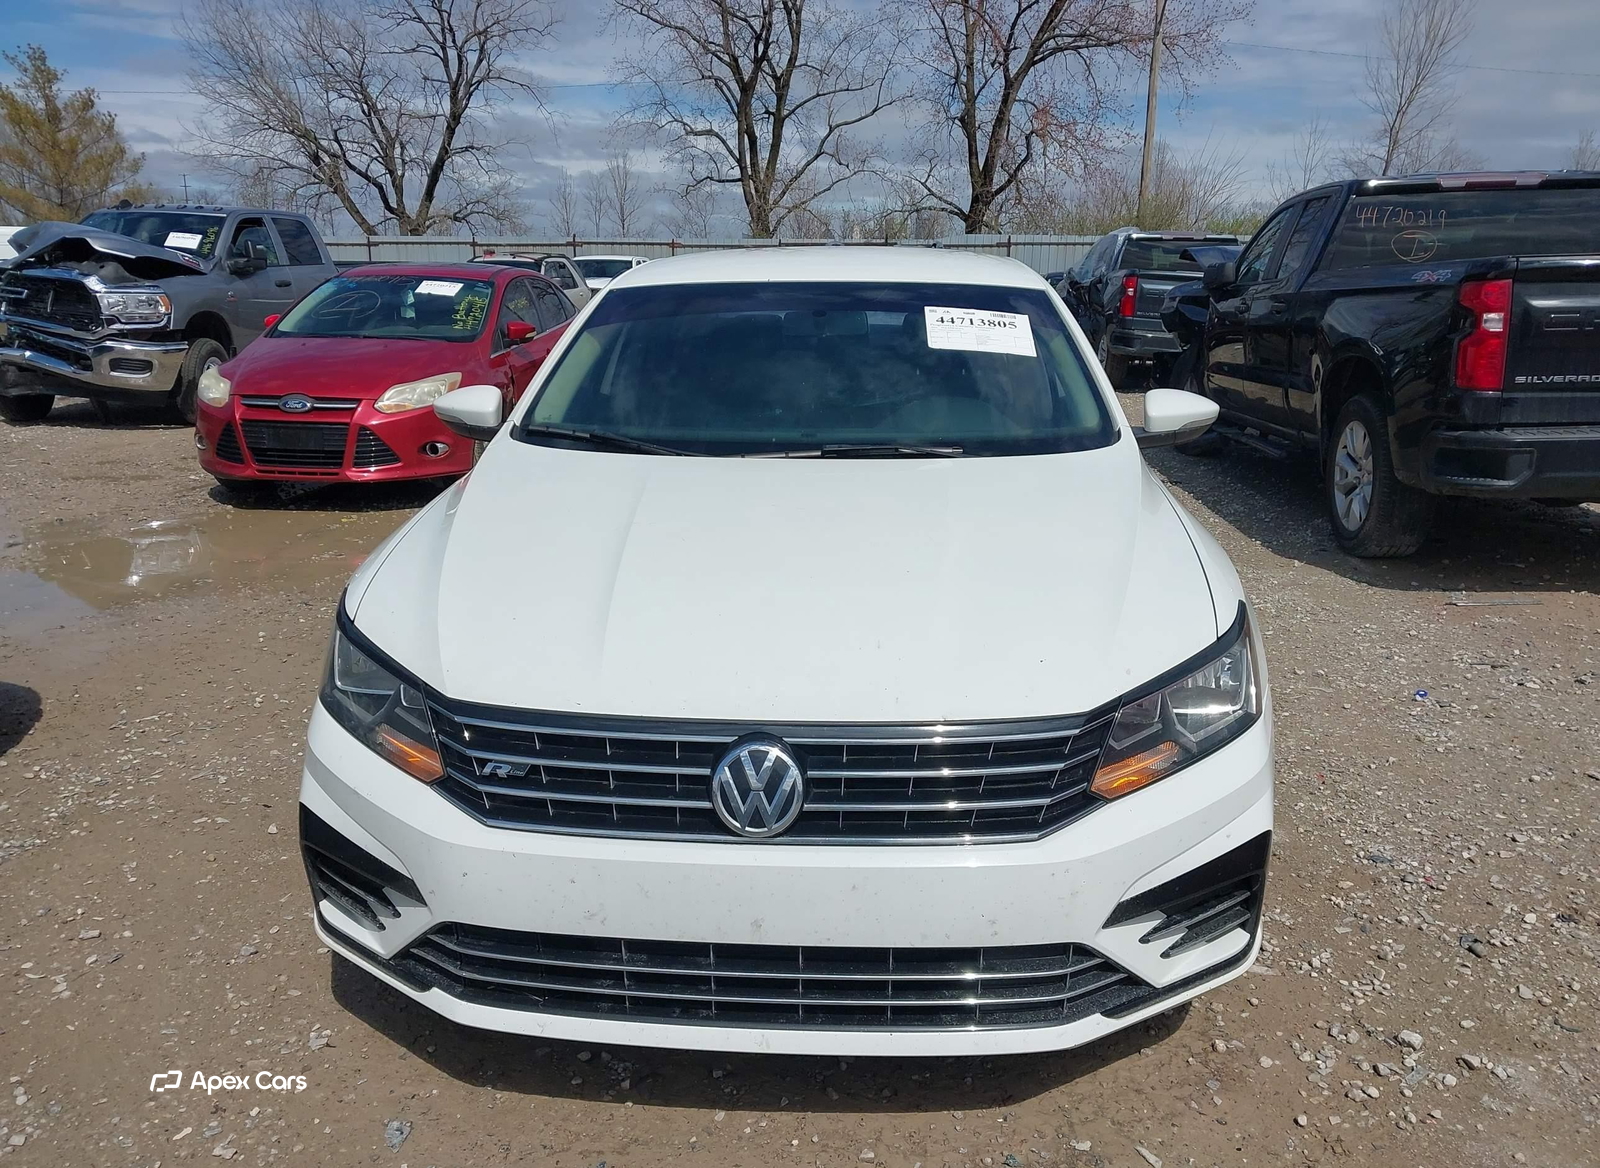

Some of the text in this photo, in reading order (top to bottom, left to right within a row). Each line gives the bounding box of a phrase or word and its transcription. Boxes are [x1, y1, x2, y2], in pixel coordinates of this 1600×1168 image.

[1356, 205, 1447, 229] 44720219
[935, 315, 1017, 329] 44713805
[285, 400, 303, 409] Ford
